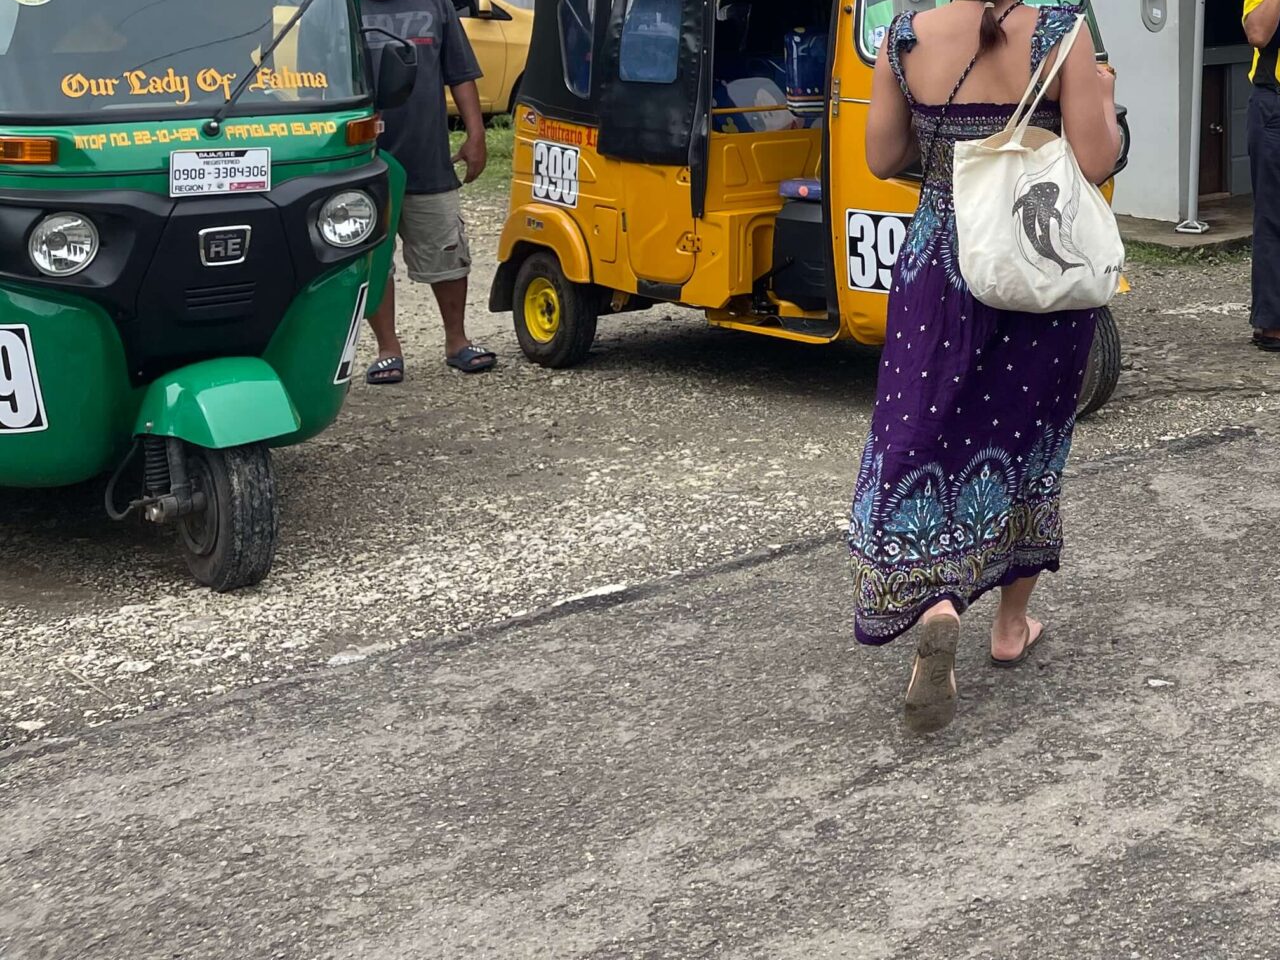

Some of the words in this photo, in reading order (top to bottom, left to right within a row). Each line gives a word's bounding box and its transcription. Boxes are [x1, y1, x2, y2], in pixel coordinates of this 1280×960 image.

[60, 73, 119, 98] Our
[123, 68, 190, 104] Lady
[196, 68, 236, 100] Of
[73, 133, 107, 149] MTOP
[133, 127, 200, 145] 22-10-439
[224, 123, 289, 141] PANGLAO
[290, 121, 337, 138] ISLAND
[535, 142, 577, 204] 398
[175, 184, 204, 192] REGION
[209, 238, 241, 257] RE
